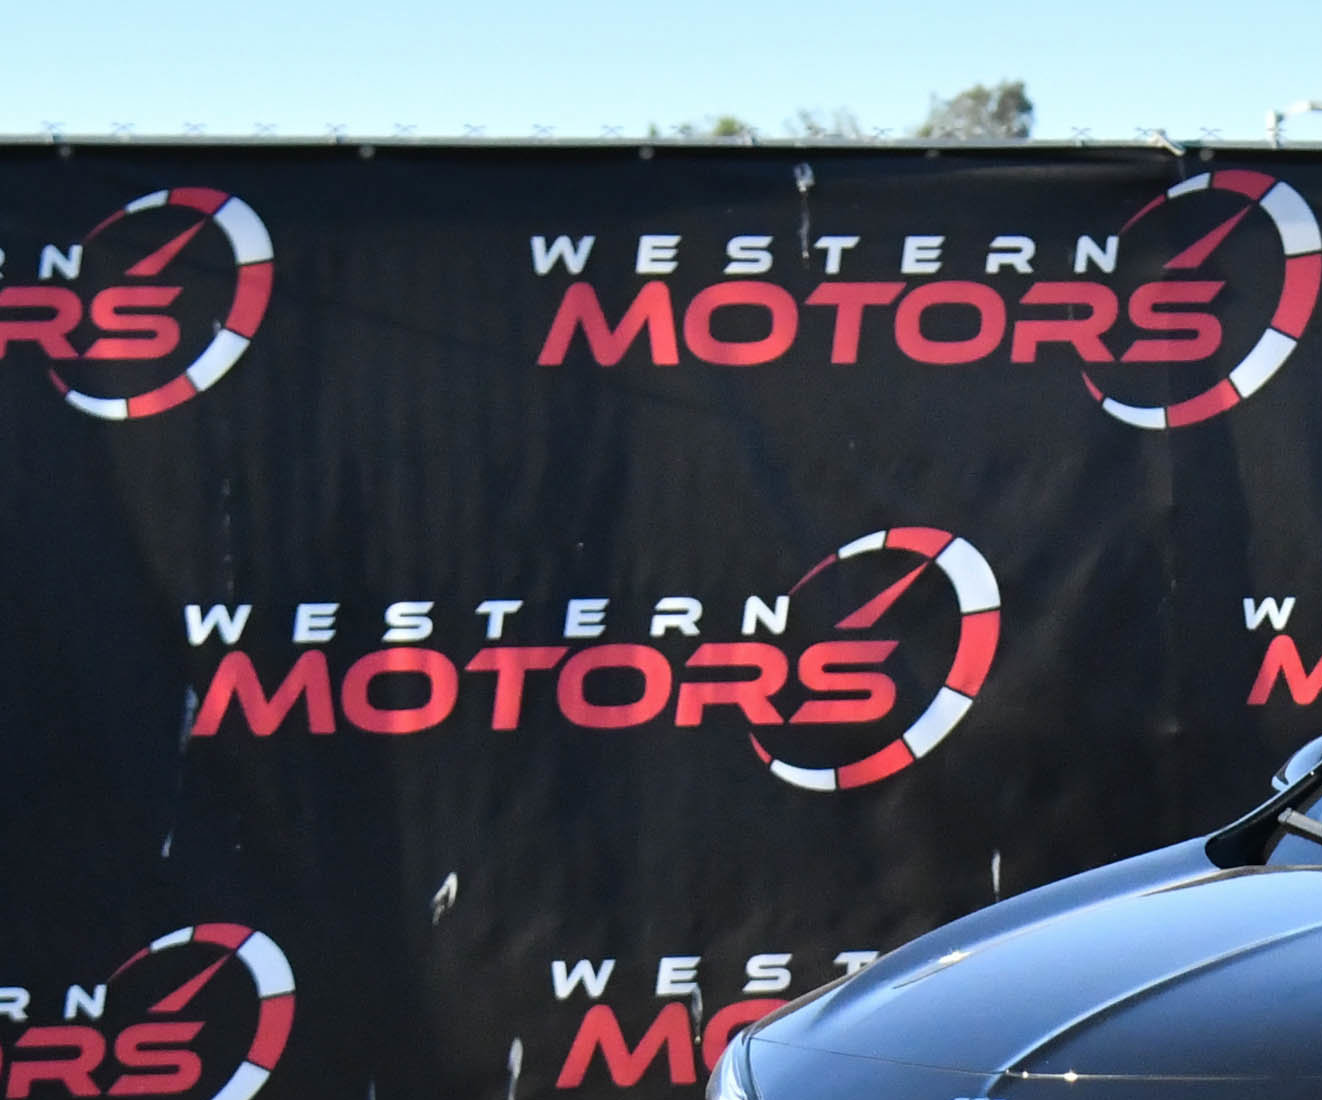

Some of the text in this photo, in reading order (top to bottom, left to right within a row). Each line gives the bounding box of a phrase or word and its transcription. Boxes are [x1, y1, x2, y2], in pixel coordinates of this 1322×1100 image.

[532, 235, 1119, 275] WESTERN
[537, 280, 1226, 367] MOTORS
[185, 595, 790, 645] WESTERN
[192, 640, 899, 737] MOTORS
[0, 1021, 206, 1099] RS
